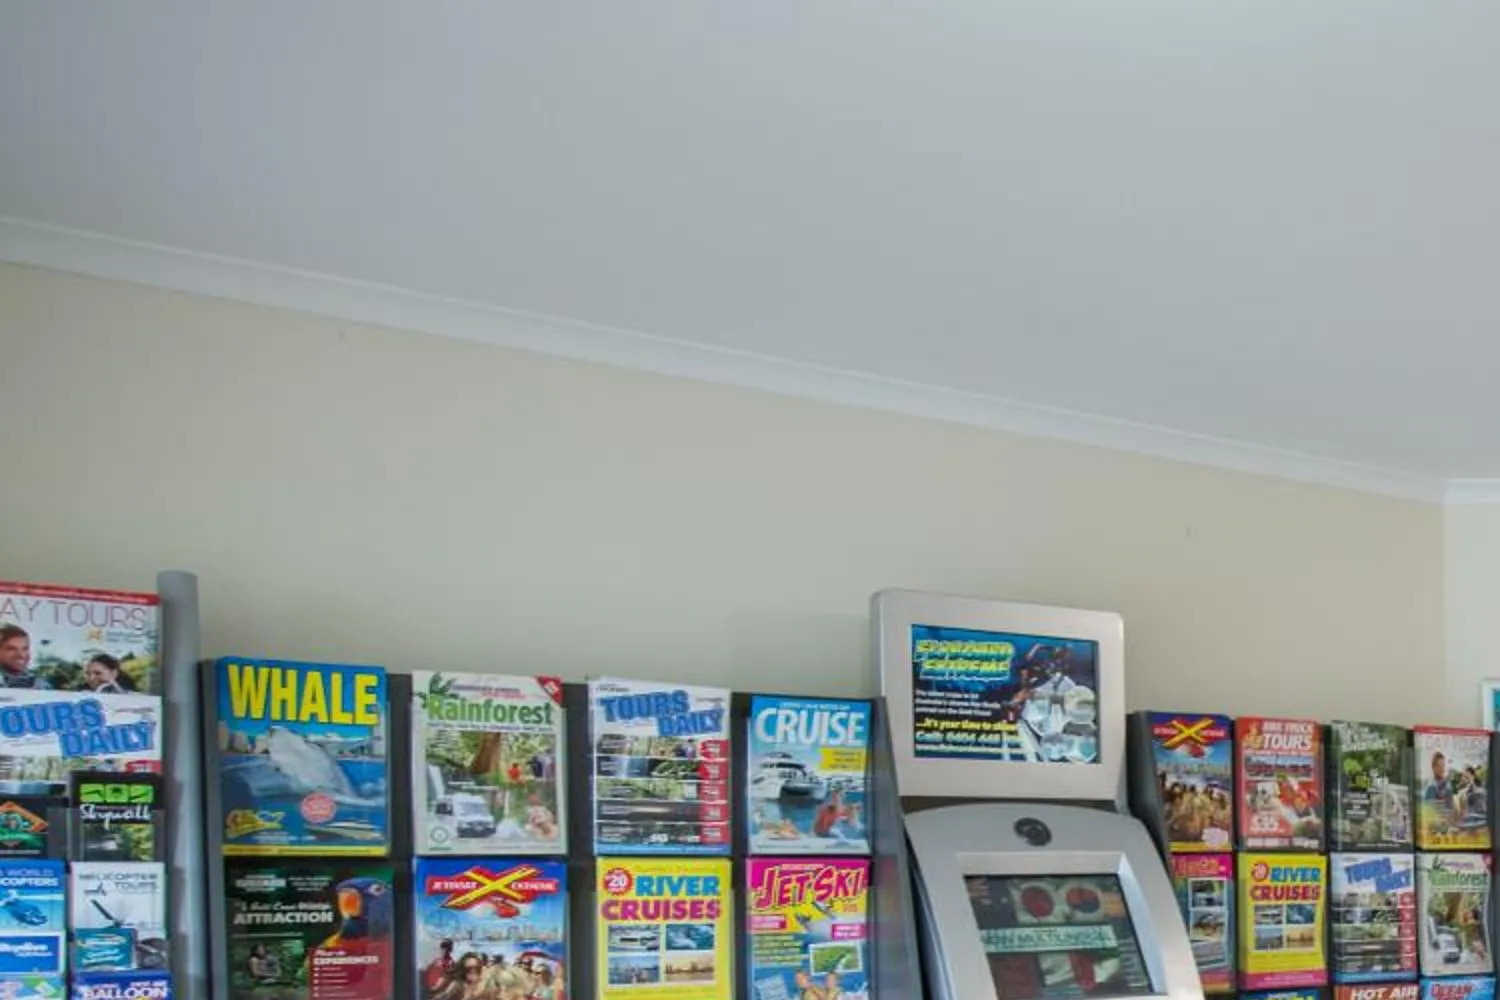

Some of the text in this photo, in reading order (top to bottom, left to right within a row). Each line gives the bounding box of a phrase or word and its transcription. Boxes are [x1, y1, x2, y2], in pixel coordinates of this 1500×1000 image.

[52, 600, 147, 630] TOURS
[227, 664, 379, 726] WHALE
[598, 690, 690, 722] TOURS
[427, 698, 554, 724] Rainforest
[658, 708, 725, 737] DAILY
[755, 707, 865, 746] CRUISE
[58, 721, 156, 758] DAILY
[1262, 733, 1312, 750] TOURS
[79, 872, 158, 882] HELICOPTER
[1270, 866, 1321, 882] RIVER
[636, 875, 720, 897] RIVER
[755, 866, 865, 910] JET SKI
[1250, 885, 1321, 901] CRUISES
[233, 912, 334, 925] ATTRACTION
[601, 899, 722, 921] CRUISES
[84, 985, 169, 1000] BALLOON
[1351, 985, 1419, 1000] HOT AIR
